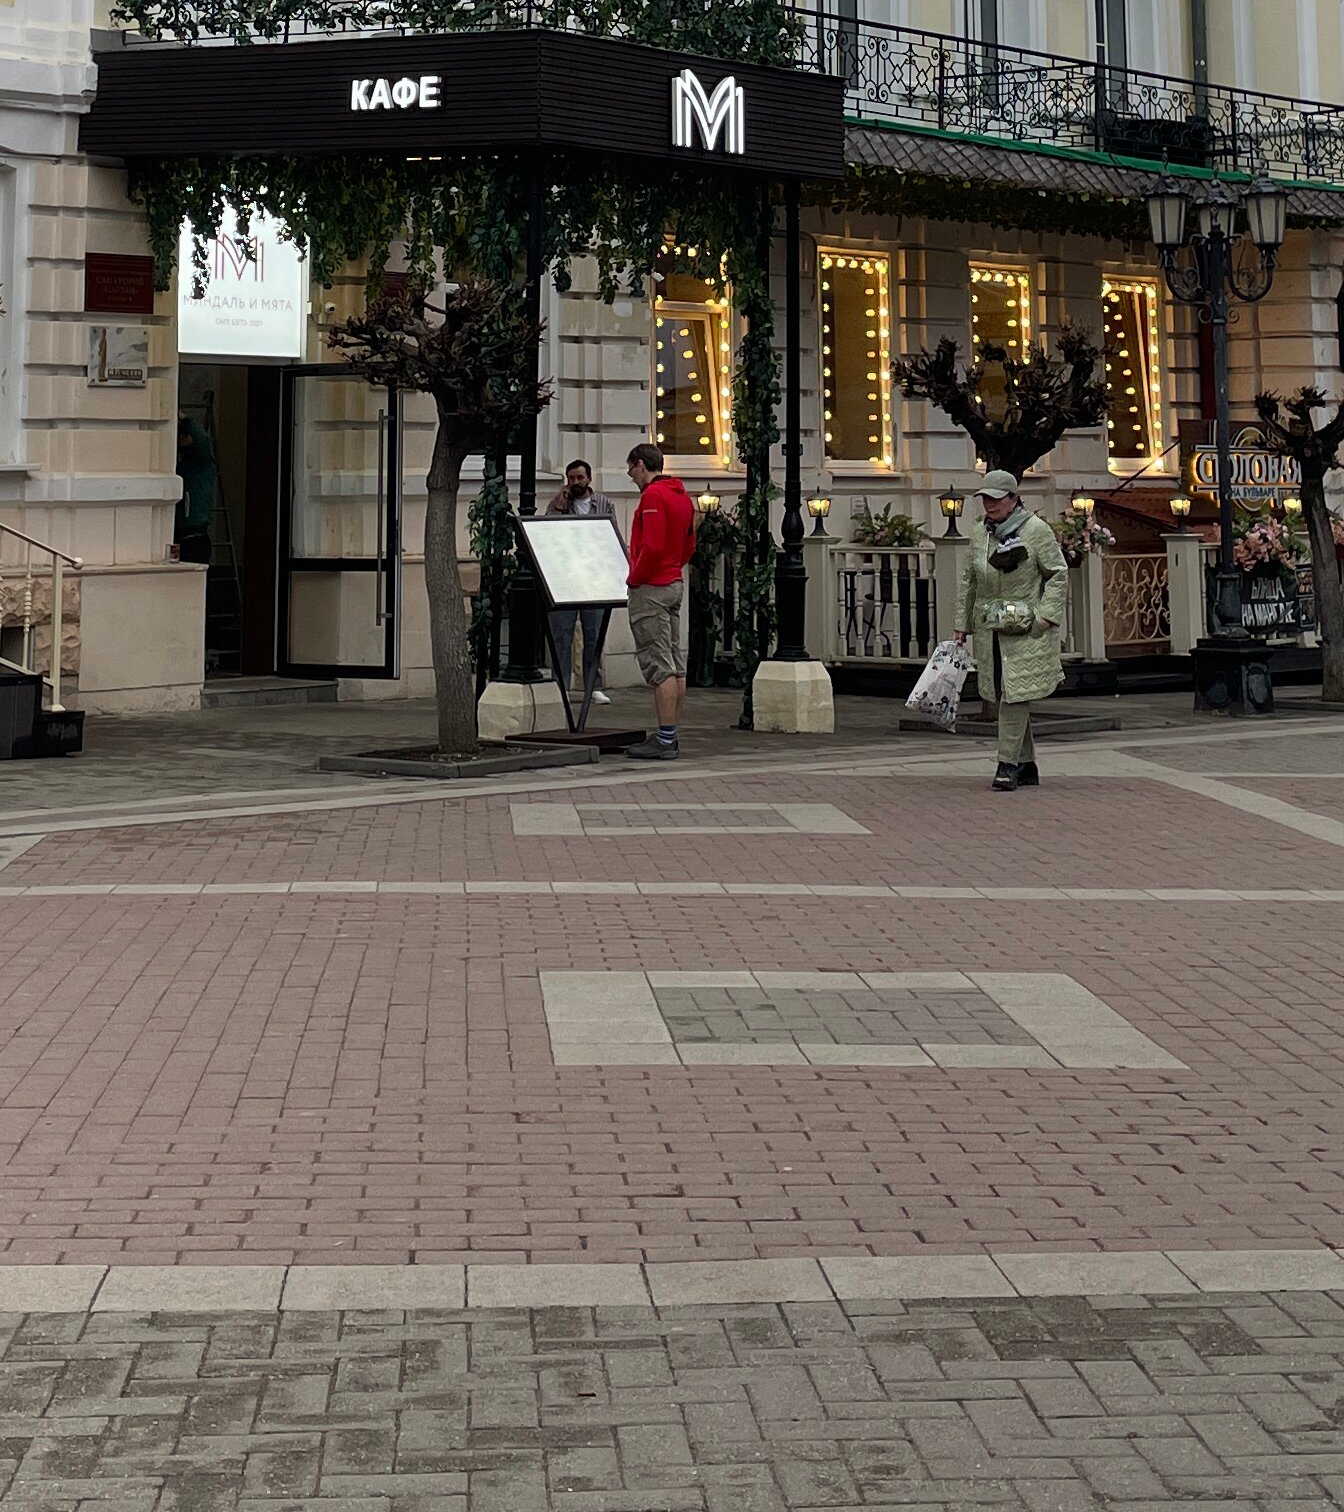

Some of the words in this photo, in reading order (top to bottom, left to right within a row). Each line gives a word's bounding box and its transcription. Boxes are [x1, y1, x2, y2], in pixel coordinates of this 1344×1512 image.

[350, 75, 443, 111] КАФЕ
[183, 294, 245, 310] МИНДАЛЬ
[249, 299, 258, 309] И
[261, 299, 294, 312] МЯТА
[1241, 603, 1256, 627] НА
